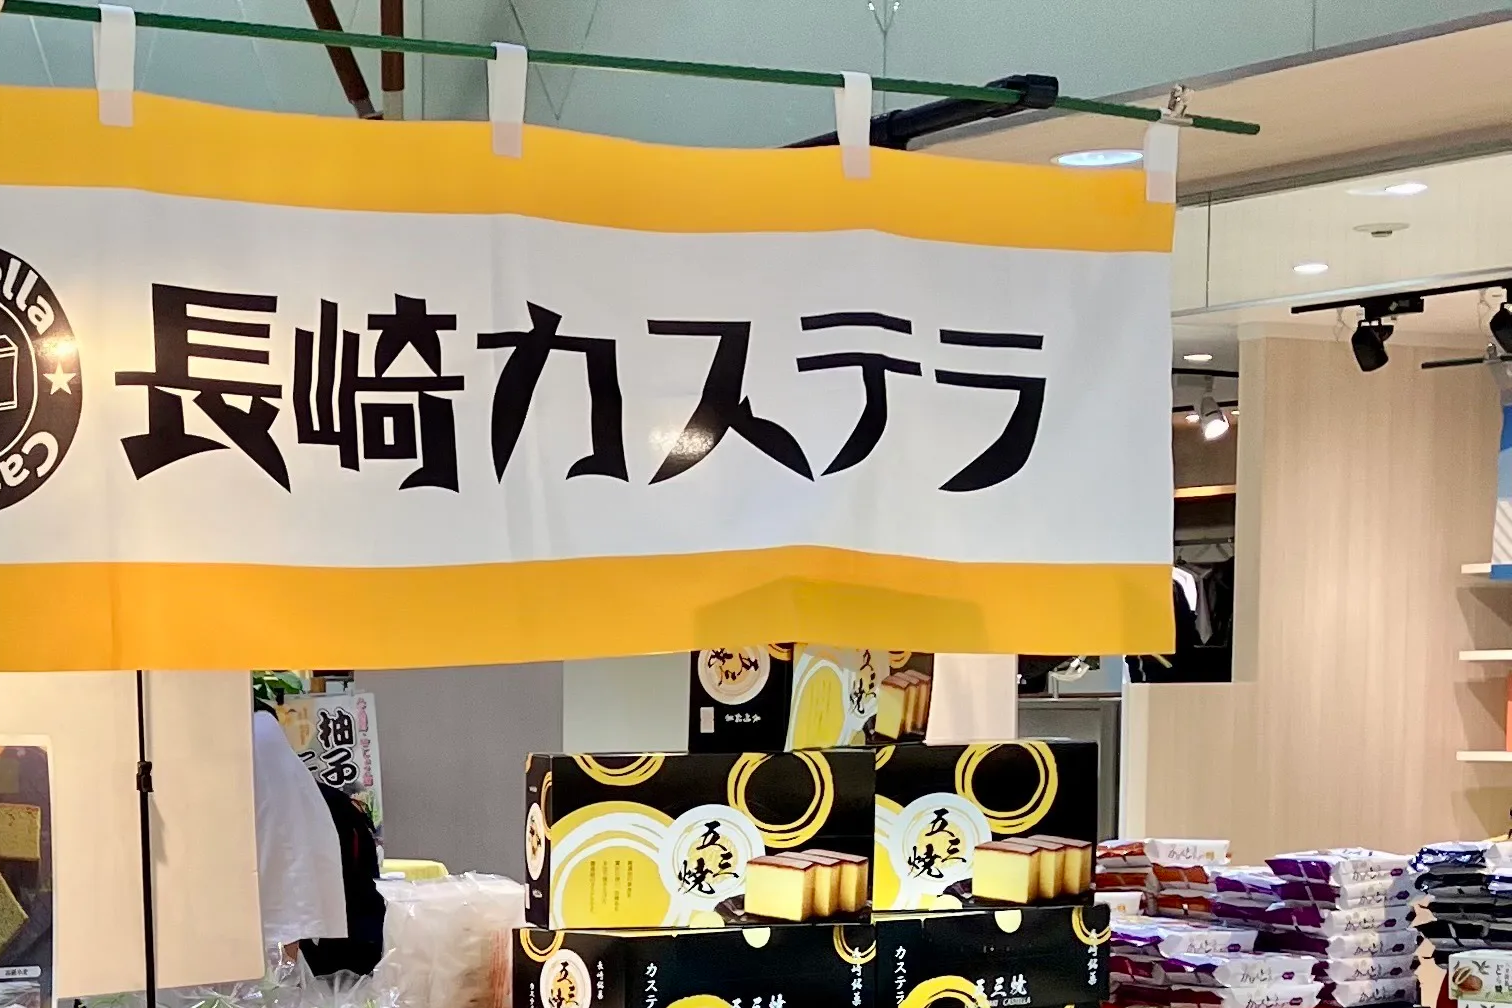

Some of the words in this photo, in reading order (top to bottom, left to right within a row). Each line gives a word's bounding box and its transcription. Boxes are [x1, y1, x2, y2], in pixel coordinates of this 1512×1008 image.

[115, 283, 1047, 494] 長崎カステラ
[677, 820, 740, 896] 五三焼
[909, 808, 966, 880] 五三焼
